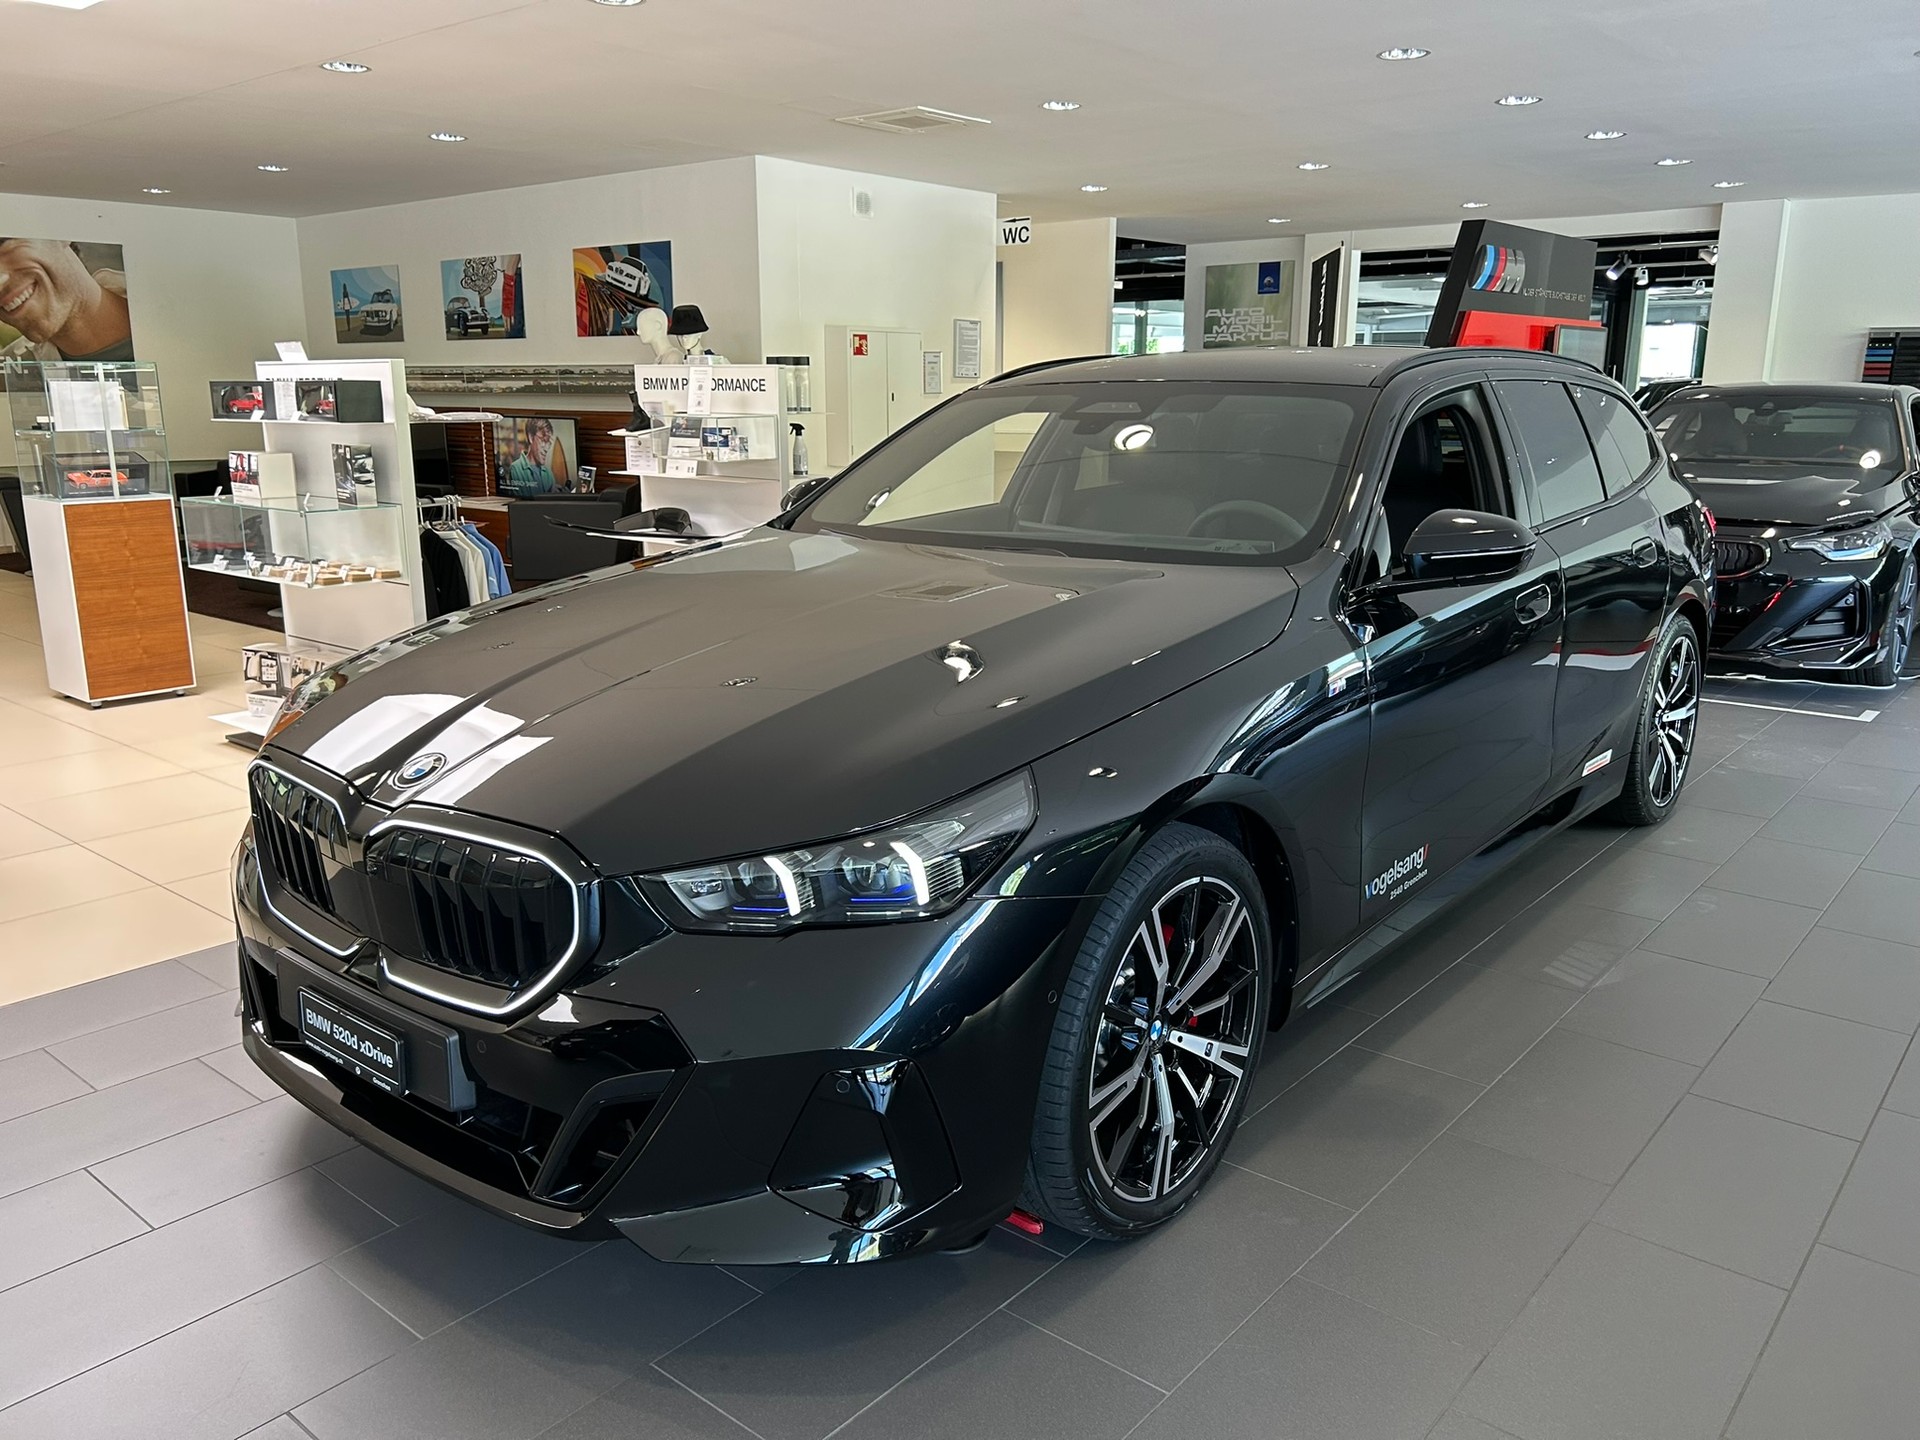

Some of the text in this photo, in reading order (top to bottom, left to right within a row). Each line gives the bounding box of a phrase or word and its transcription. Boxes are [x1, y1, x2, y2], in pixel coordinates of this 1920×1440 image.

[1003, 226, 1029, 244] WC
[1205, 307, 1265, 318] AUTO
[1220, 315, 1283, 325] MOBIL
[1212, 323, 1274, 334] MANU
[1203, 331, 1289, 342] FAKTUR
[643, 377, 767, 392] BMW M PORMANCE
[1390, 884, 1403, 900] 2540
[305, 1008, 394, 1068] BMW 520d xDrive
